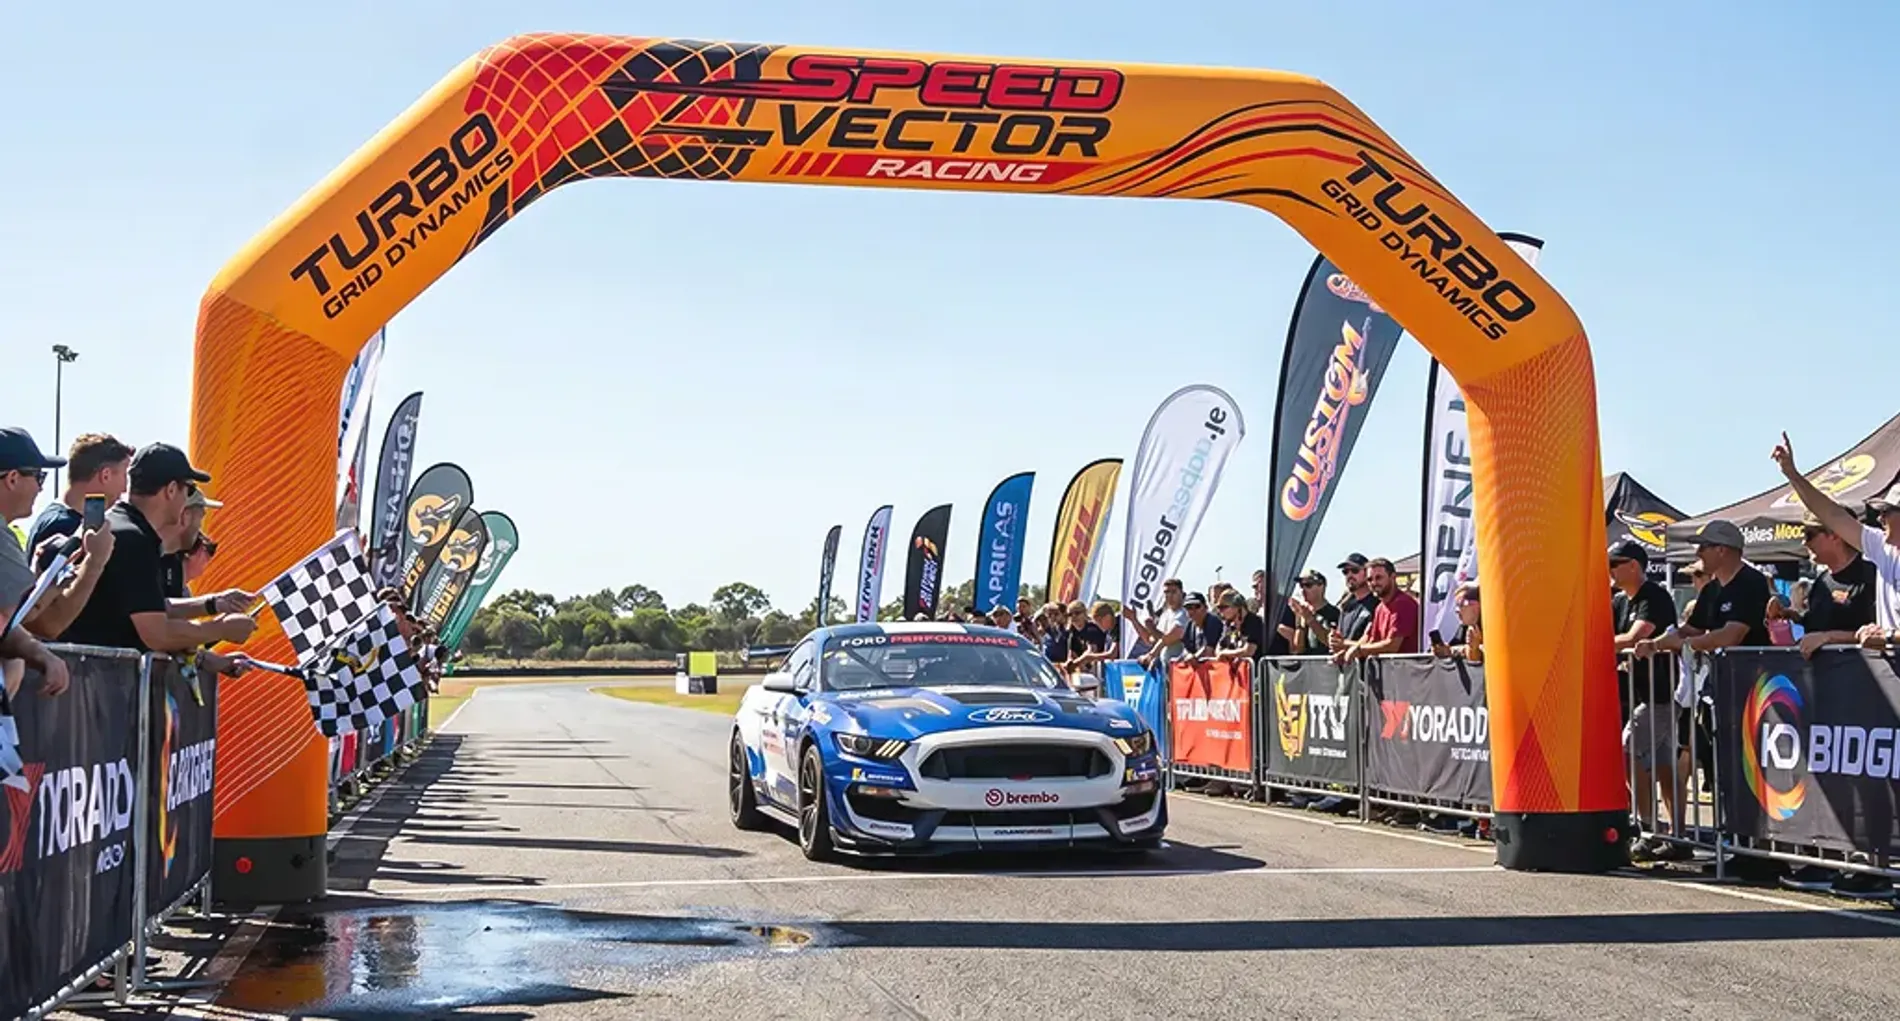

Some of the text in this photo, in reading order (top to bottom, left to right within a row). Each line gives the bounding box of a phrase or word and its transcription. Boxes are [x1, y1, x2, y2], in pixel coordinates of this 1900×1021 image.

[786, 54, 1124, 112] SPEED
[779, 104, 1112, 157] VECTOR
[866, 158, 1048, 182] RACING
[290, 112, 501, 297] TURBO
[322, 149, 514, 319] GRID DYNAMICS
[1320, 178, 1382, 231] GRID
[1380, 230, 1508, 341] DYNAMICS
[1345, 150, 1536, 322] TURBO
[1280, 319, 1364, 521] CUSTOM
[841, 634, 1019, 647] FORD PERFORMANCE
[986, 706, 1037, 722] Ford
[1006, 791, 1060, 805] brembo
